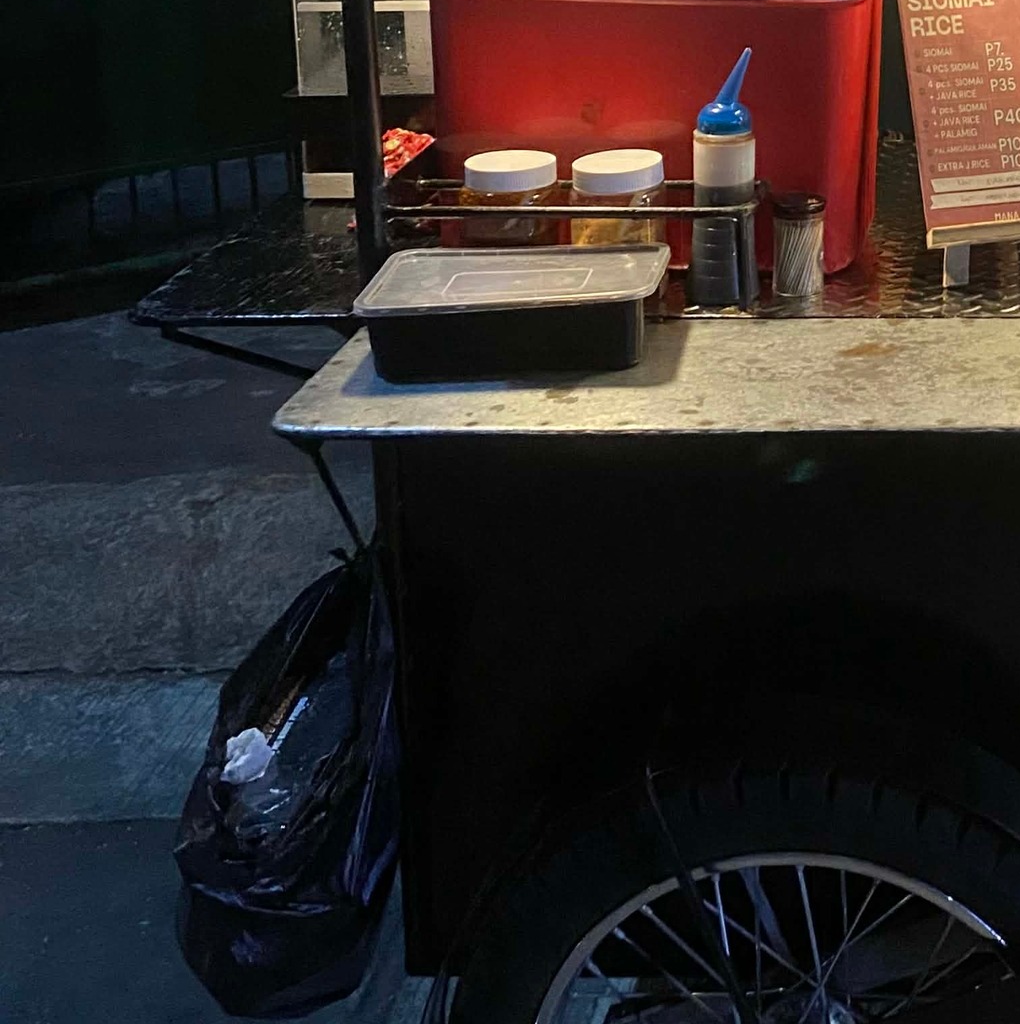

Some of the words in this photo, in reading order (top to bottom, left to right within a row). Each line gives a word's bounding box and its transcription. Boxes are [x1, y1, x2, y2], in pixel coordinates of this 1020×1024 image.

[910, 13, 965, 37] RICE
[923, 47, 953, 57] SIOMAI
[925, 64, 932, 74] 4
[932, 64, 950, 74] PCS
[950, 62, 980, 72] SIOMAI
[987, 57, 1014, 73] P25
[954, 77, 984, 87] SIOMAI
[989, 77, 1017, 93] P35
[936, 90, 958, 101] JAVA
[959, 89, 978, 99] RICE
[958, 103, 988, 113] SIOMAI
[939, 116, 961, 127] JAVA
[962, 115, 981, 125] RICE
[940, 128, 978, 139] PALAMIG
[937, 160, 964, 172] EXTRA
[994, 211, 1020, 222] MANA
